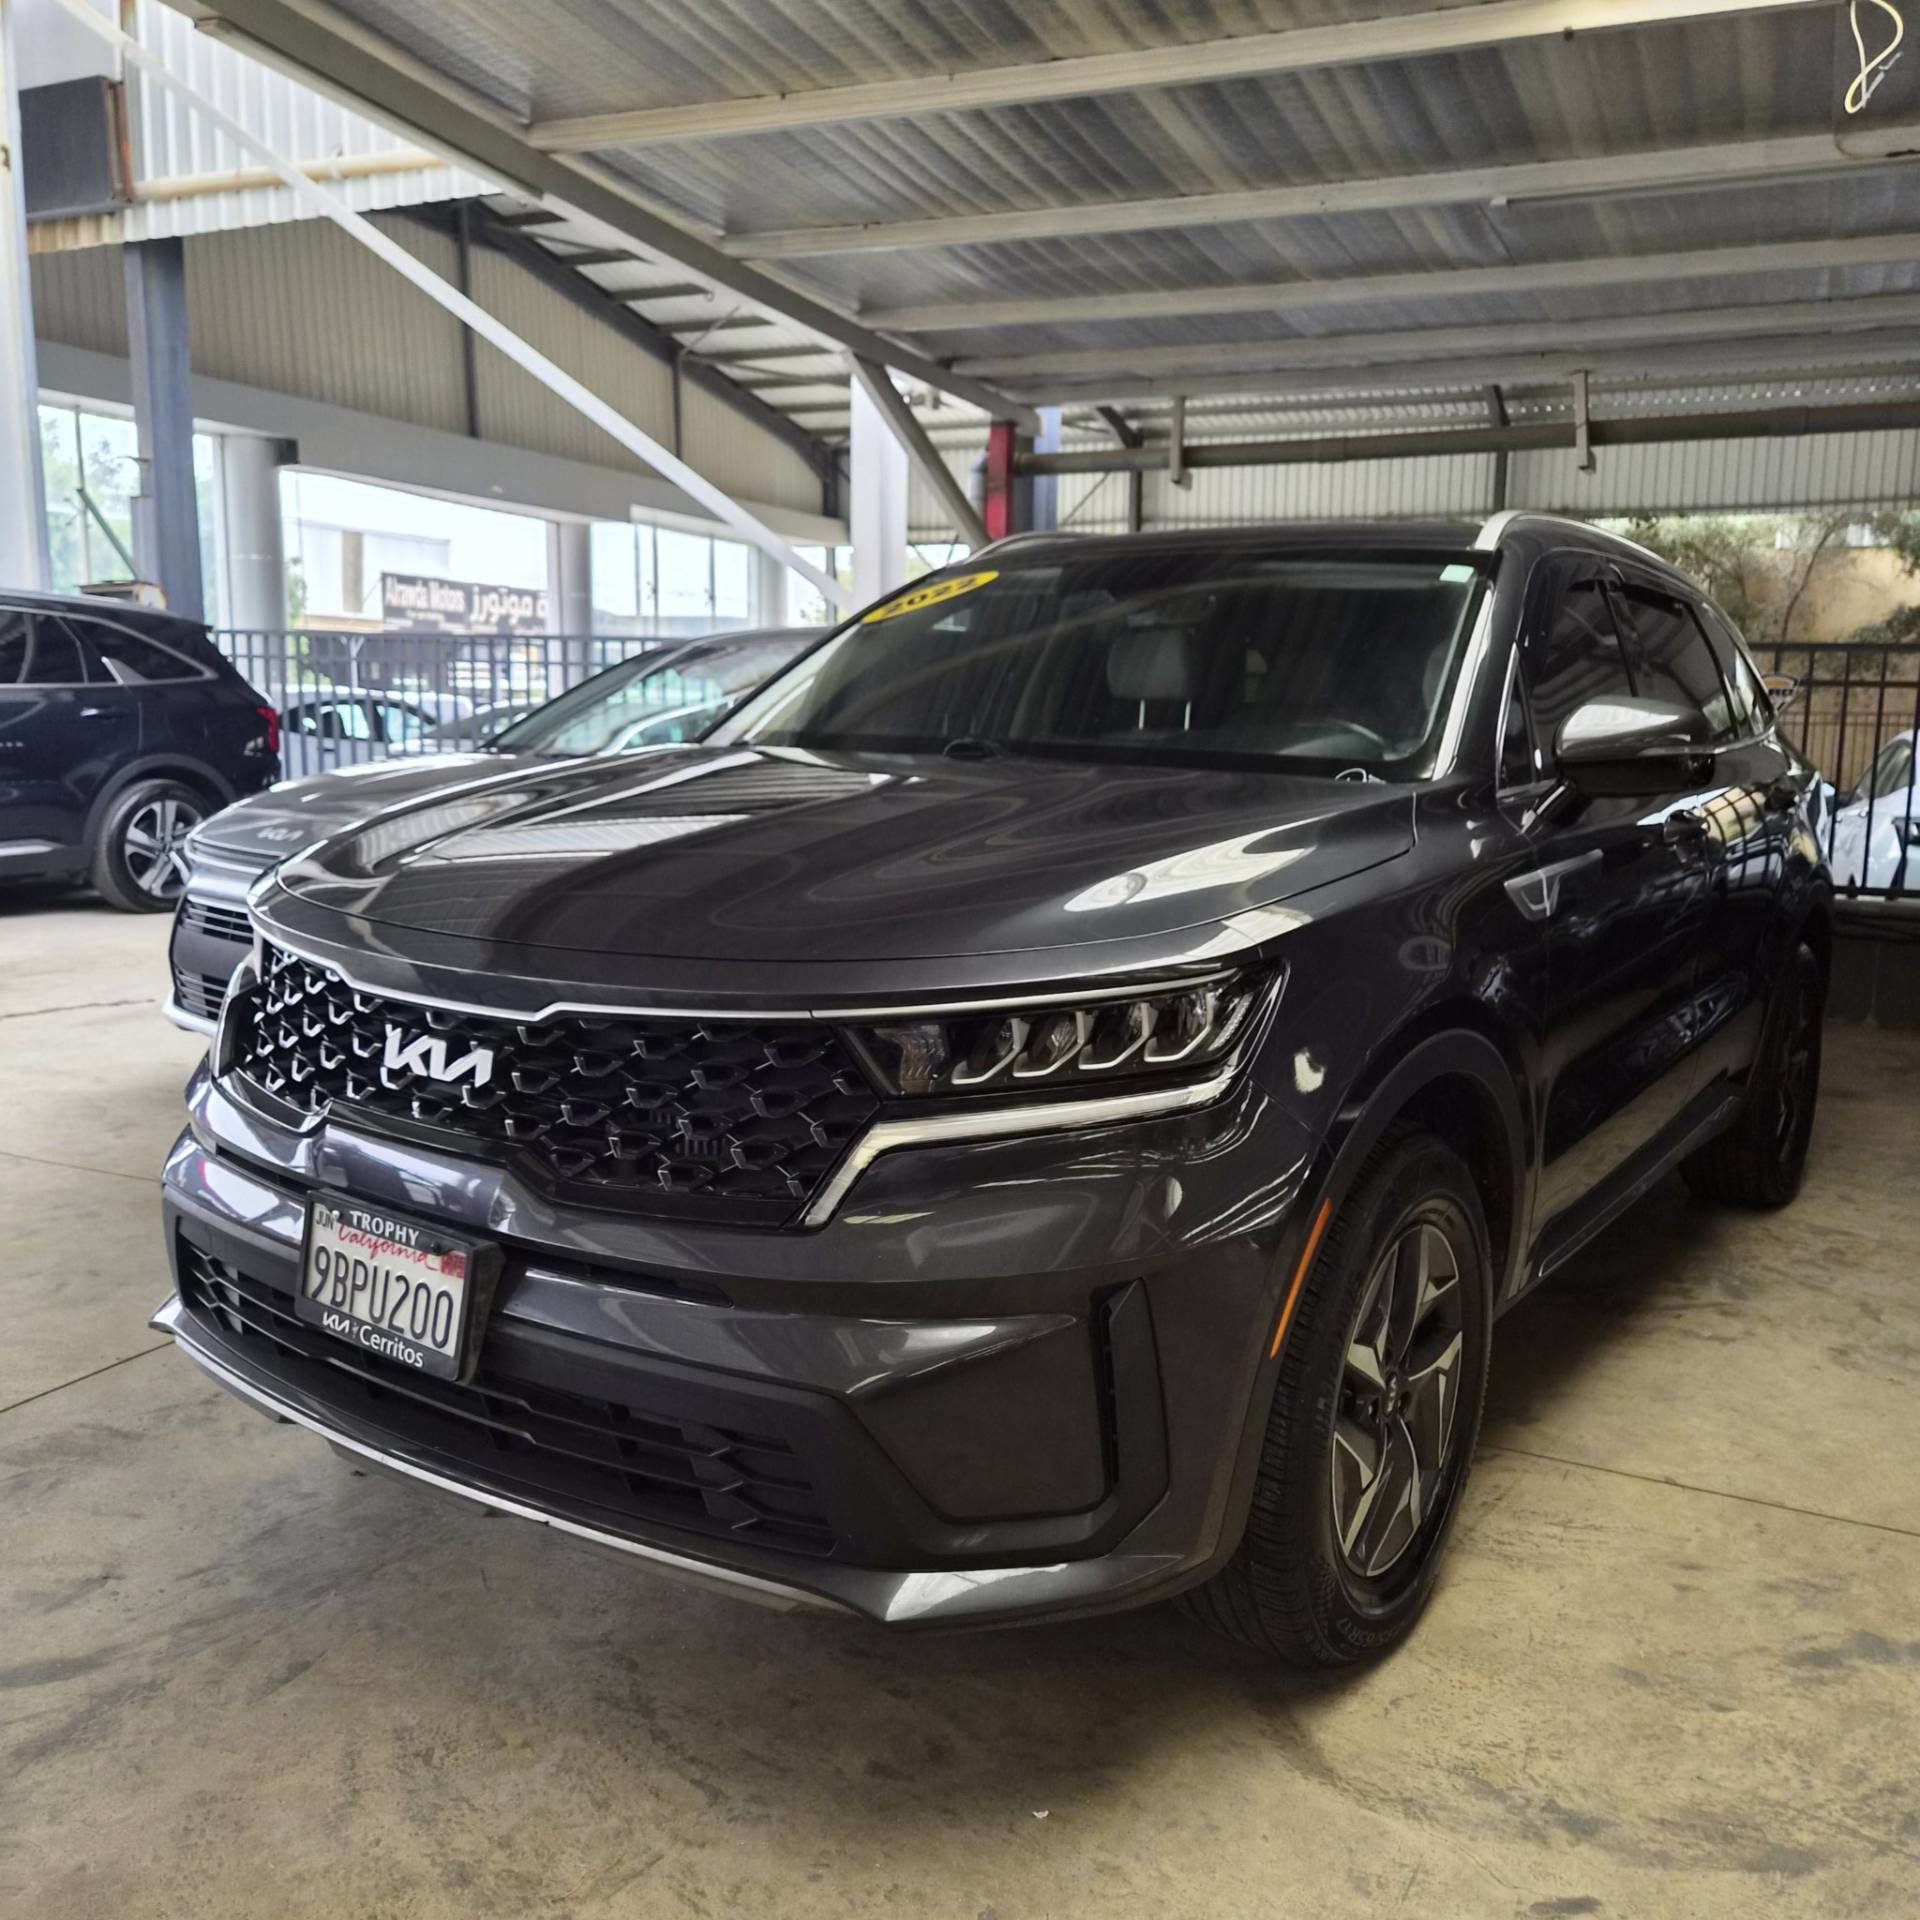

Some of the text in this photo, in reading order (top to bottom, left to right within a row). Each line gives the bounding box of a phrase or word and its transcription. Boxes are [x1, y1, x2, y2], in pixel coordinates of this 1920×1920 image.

[384, 1023, 494, 1088] KIA
[349, 1210, 419, 1246] TROPHY
[311, 1245, 453, 1349] 9BPU200
[322, 1311, 424, 1368] KIA Cerritos
